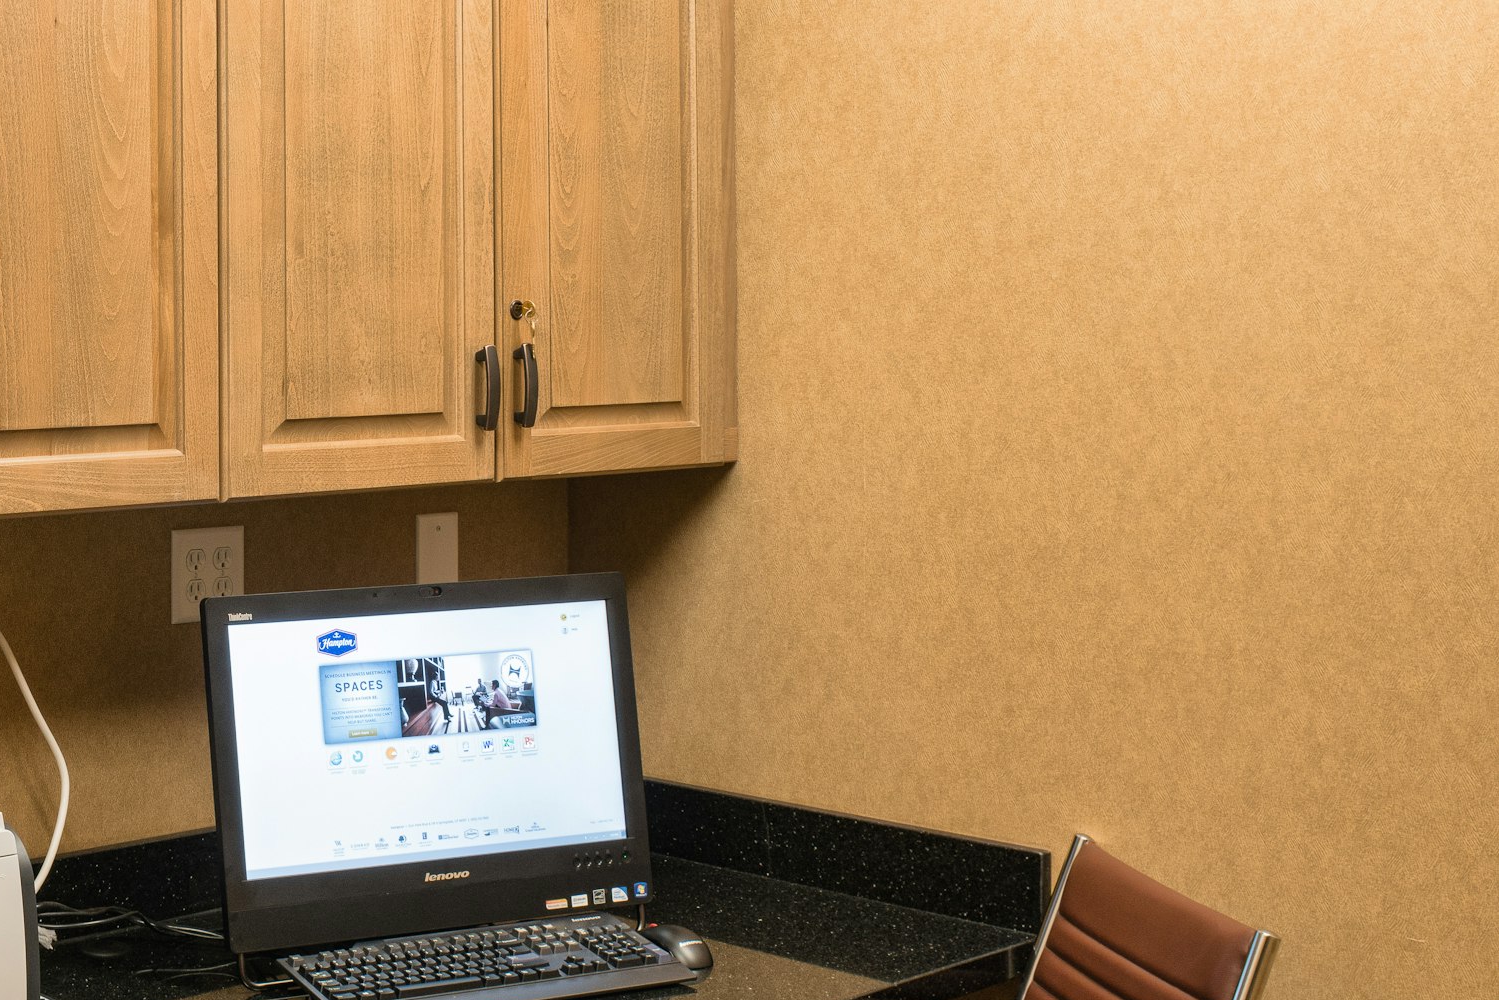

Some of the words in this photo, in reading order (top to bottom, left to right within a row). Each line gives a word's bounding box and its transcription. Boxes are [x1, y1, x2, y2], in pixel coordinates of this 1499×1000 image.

[319, 638, 356, 650] Hampton
[335, 680, 383, 693] SPACES
[424, 870, 470, 882] lenovo
